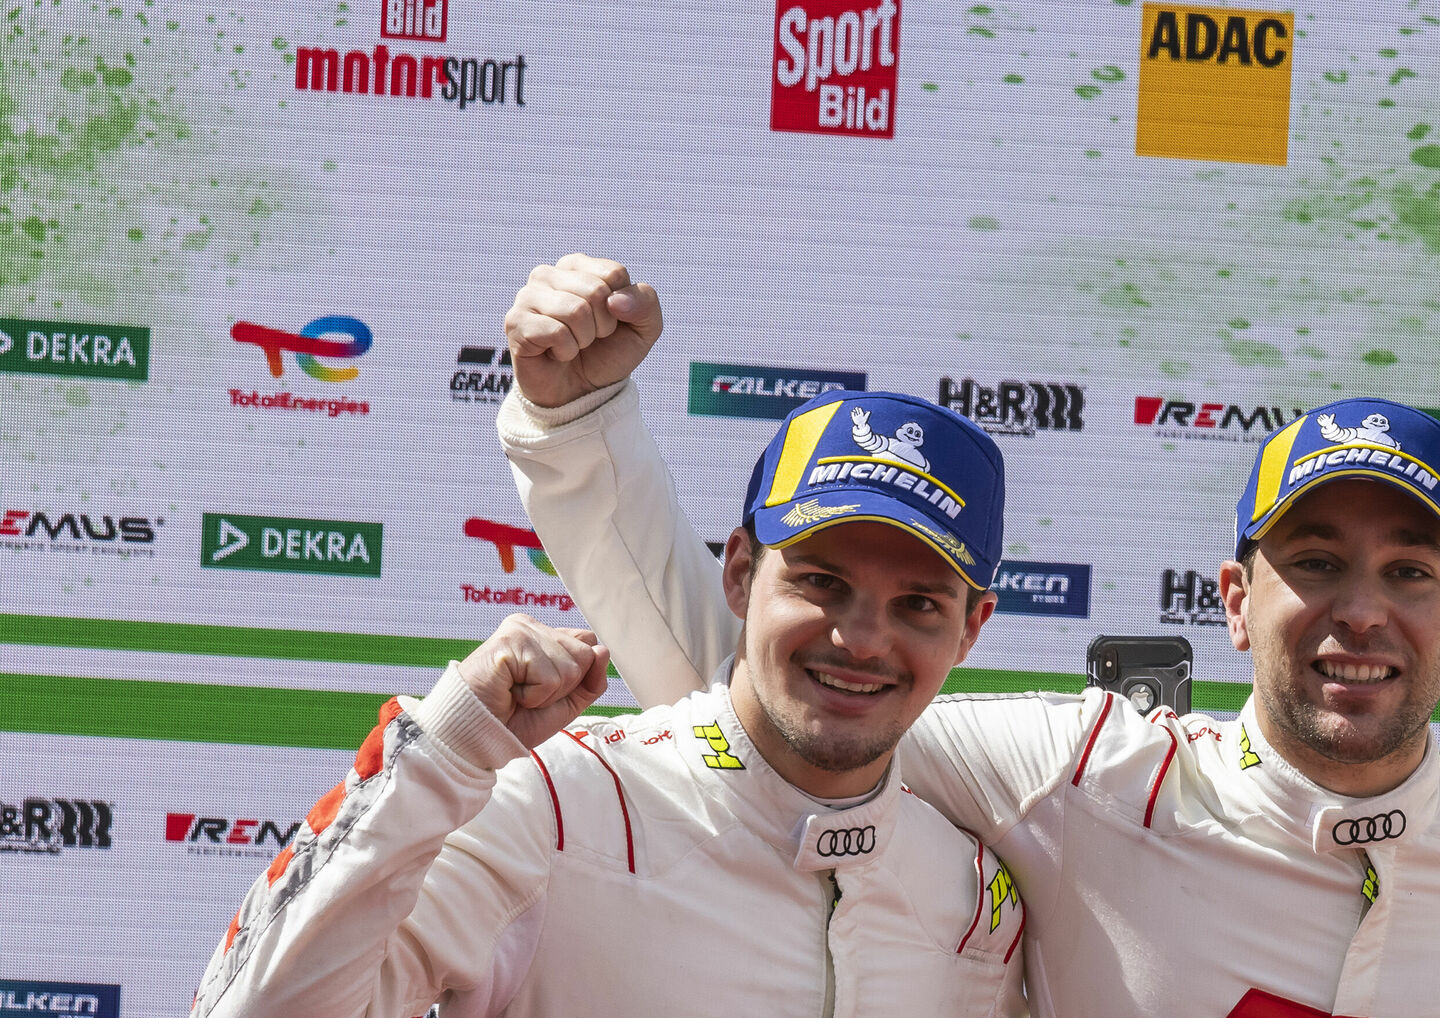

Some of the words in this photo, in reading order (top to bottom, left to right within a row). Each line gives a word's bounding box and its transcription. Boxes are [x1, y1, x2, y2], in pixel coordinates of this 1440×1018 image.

[777, 0, 896, 92] Sport
[1147, 11, 1288, 68] ADAC
[817, 84, 890, 131] Bild
[26, 330, 136, 368] DEKRA
[228, 388, 370, 417] TotalEnergies
[1289, 448, 1440, 491] MICHELIN
[808, 463, 964, 520] MICHELIN
[260, 526, 370, 564] DEKRA
[461, 584, 576, 611] TotalEnerg
